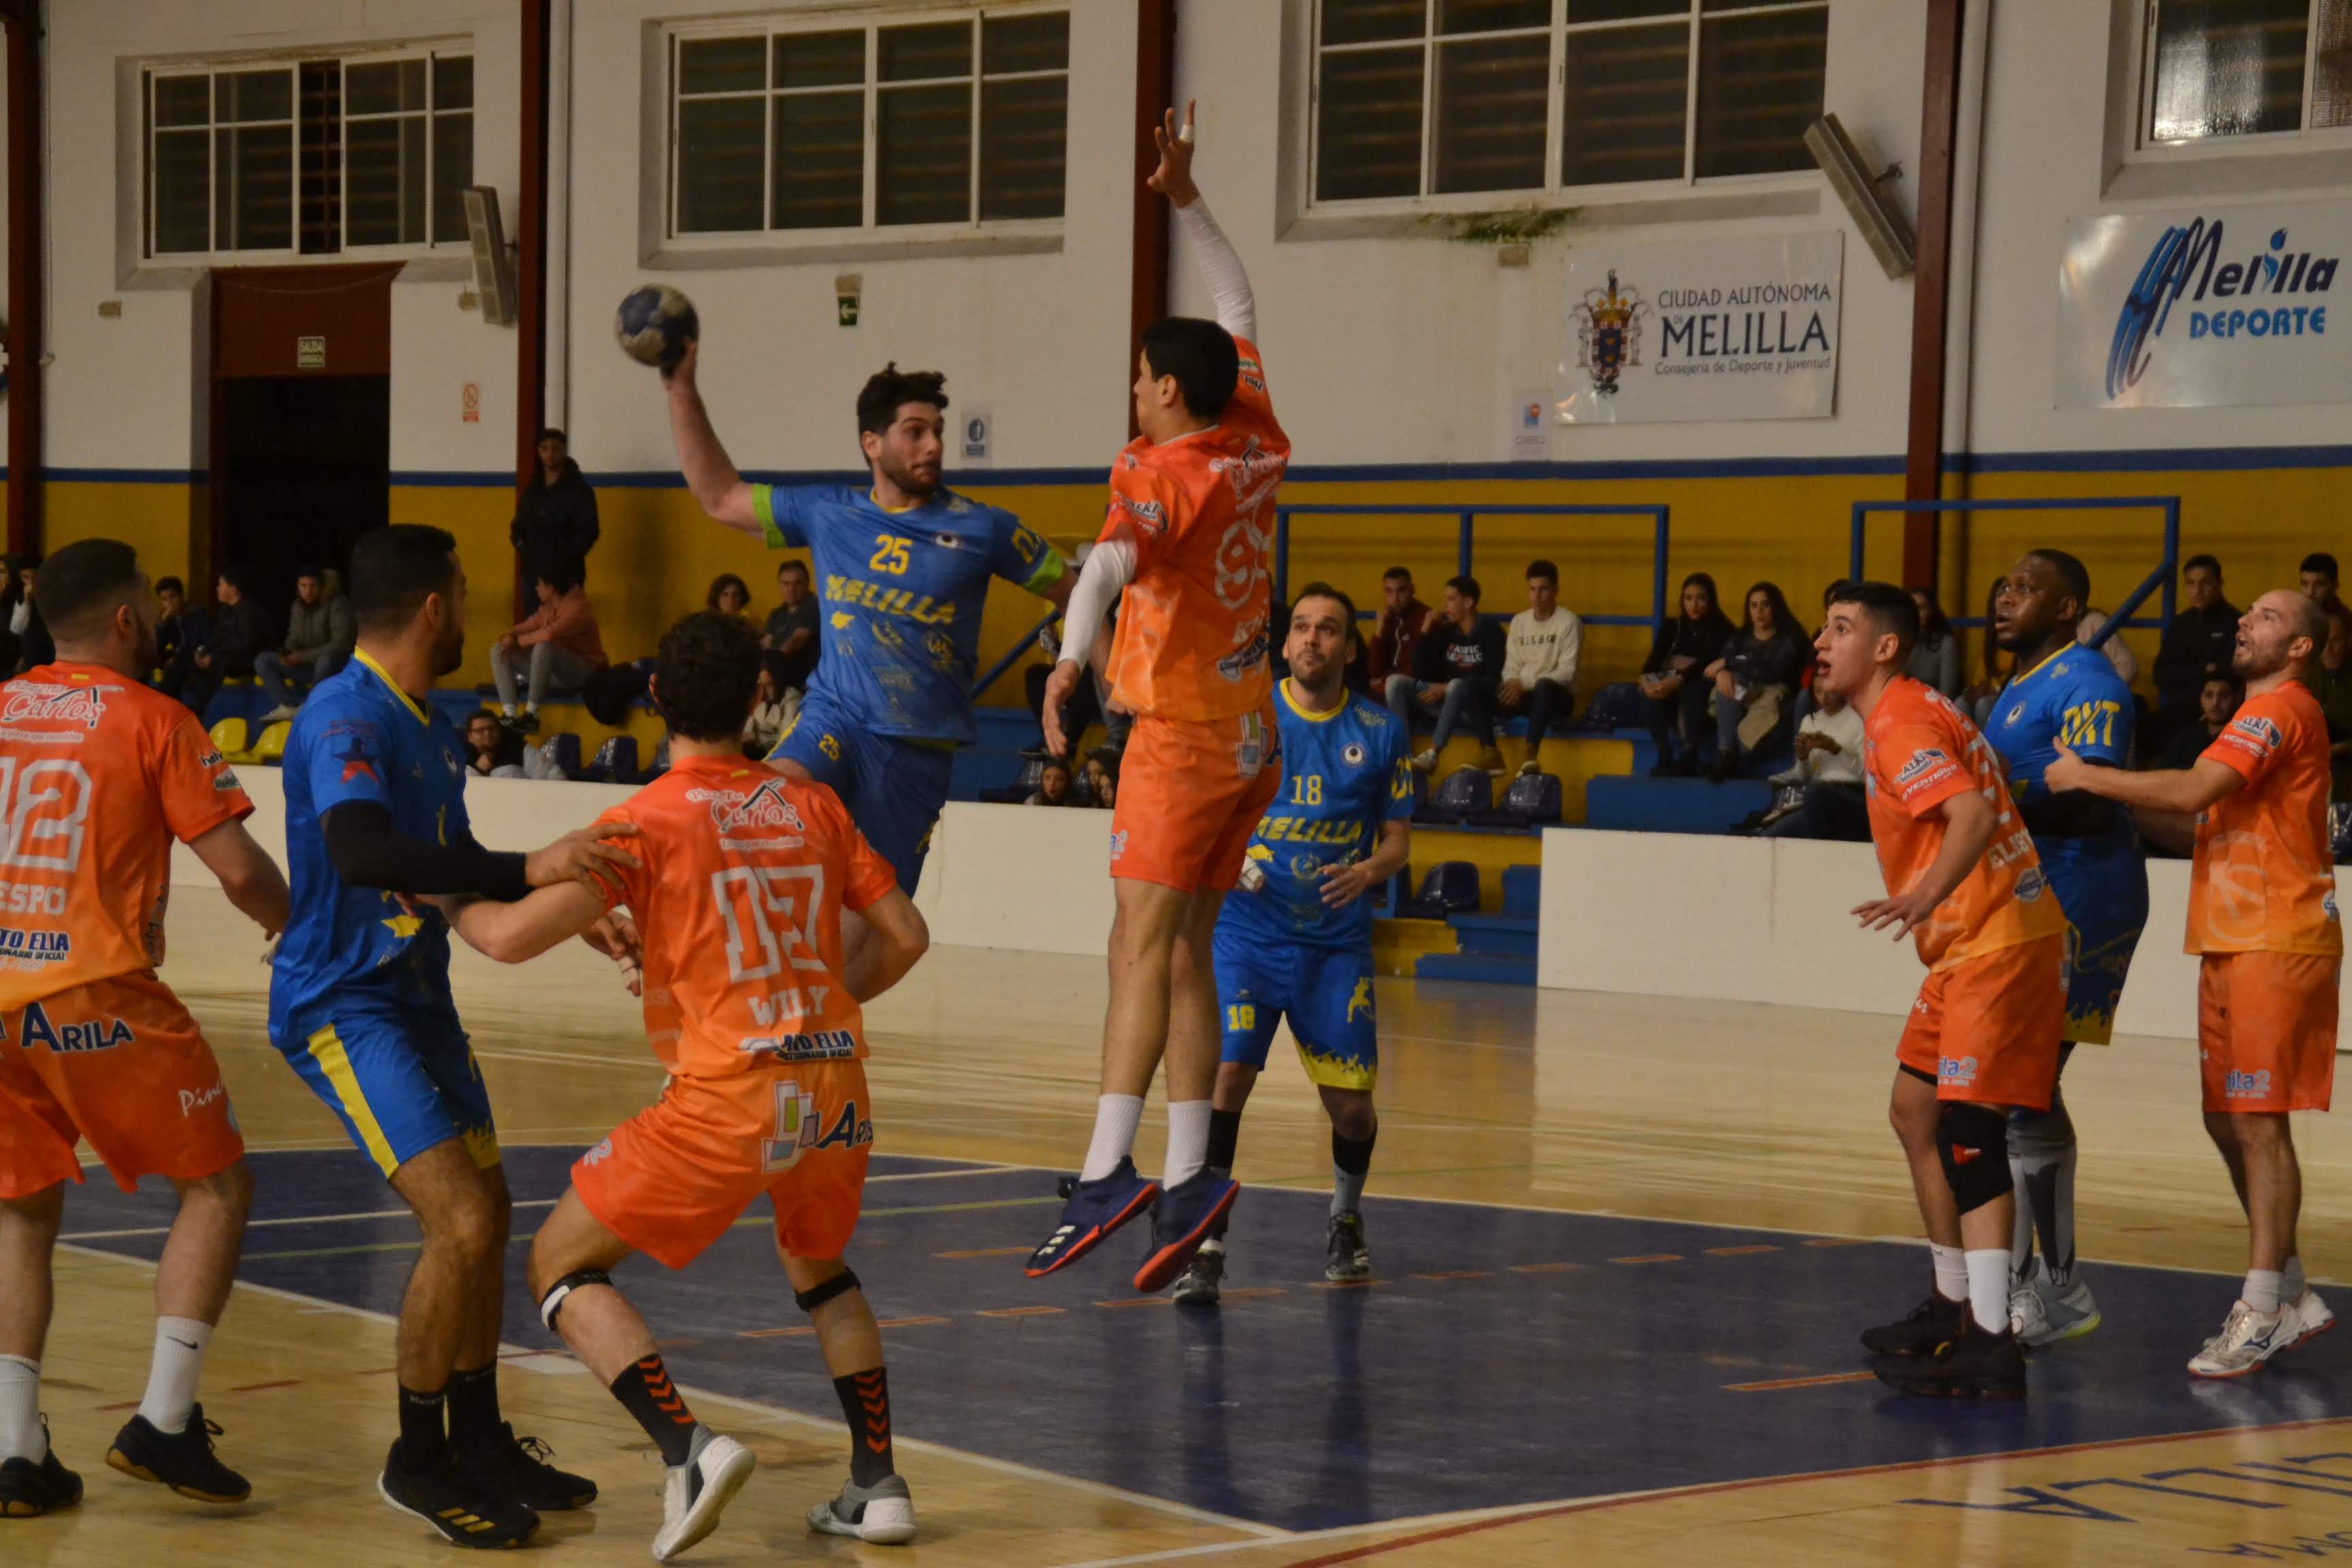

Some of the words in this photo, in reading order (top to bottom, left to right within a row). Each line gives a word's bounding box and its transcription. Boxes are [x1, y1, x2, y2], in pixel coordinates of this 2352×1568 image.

[1658, 288, 1722, 308] CIUDAD
[1727, 280, 1831, 305] AUTÓNOMA
[1661, 310, 1830, 359] MELILLA
[2189, 305, 2325, 340] DEPORTE
[1713, 361, 1726, 372] de
[1729, 359, 1774, 375] Deporte
[1776, 361, 1783, 374] y
[1785, 355, 1831, 374] Juventud
[868, 534, 913, 575] 25
[826, 573, 956, 625] MELILLA
[3, 689, 107, 722] Carlos
[819, 734, 840, 762] 25
[1291, 775, 1323, 806] 18
[28, 931, 70, 951] ELIA
[747, 984, 830, 1027] WILY
[1227, 1004, 1255, 1032] 18
[20, 1000, 134, 1052] ARILA
